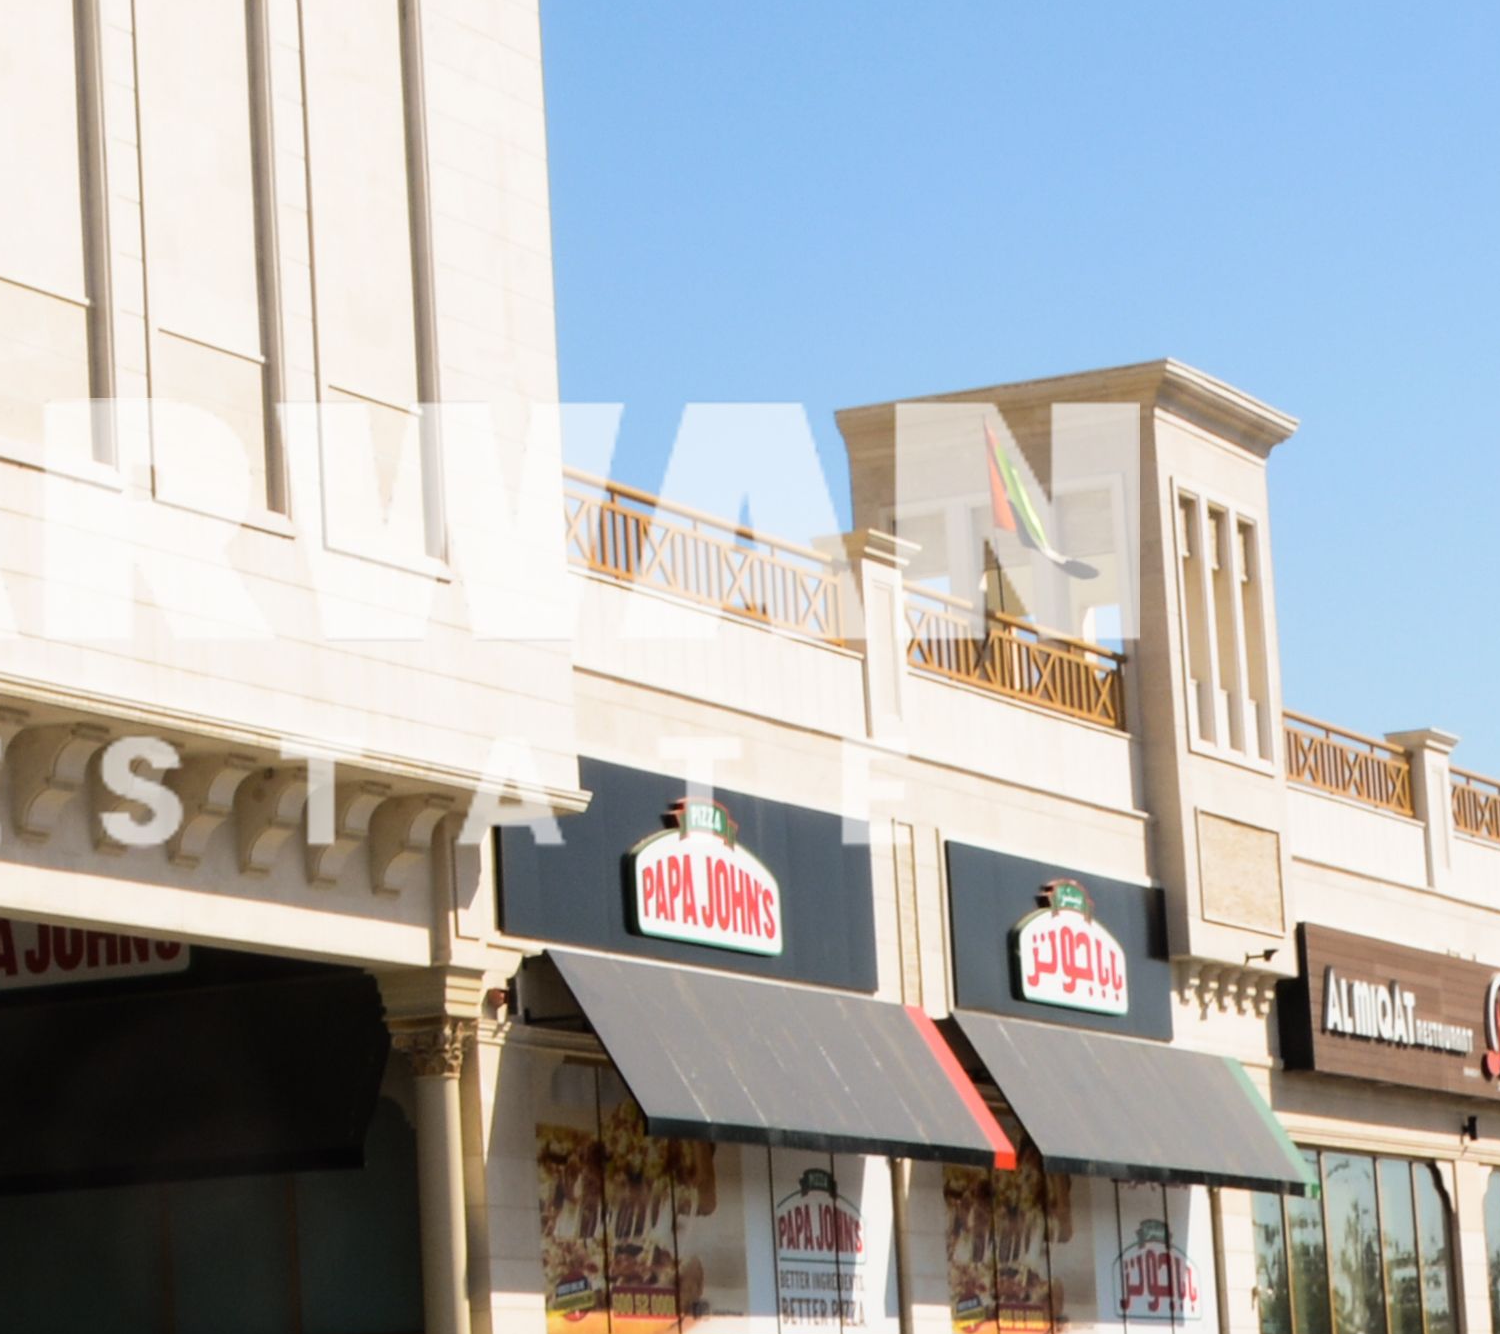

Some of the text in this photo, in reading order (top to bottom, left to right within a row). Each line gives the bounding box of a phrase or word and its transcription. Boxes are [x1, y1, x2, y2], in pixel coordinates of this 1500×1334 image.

[689, 805, 722, 832] PIZZA
[641, 854, 775, 940] PAPA JOHN'S
[778, 1203, 814, 1251] PAPA
[781, 1296, 828, 1326] BETTER
